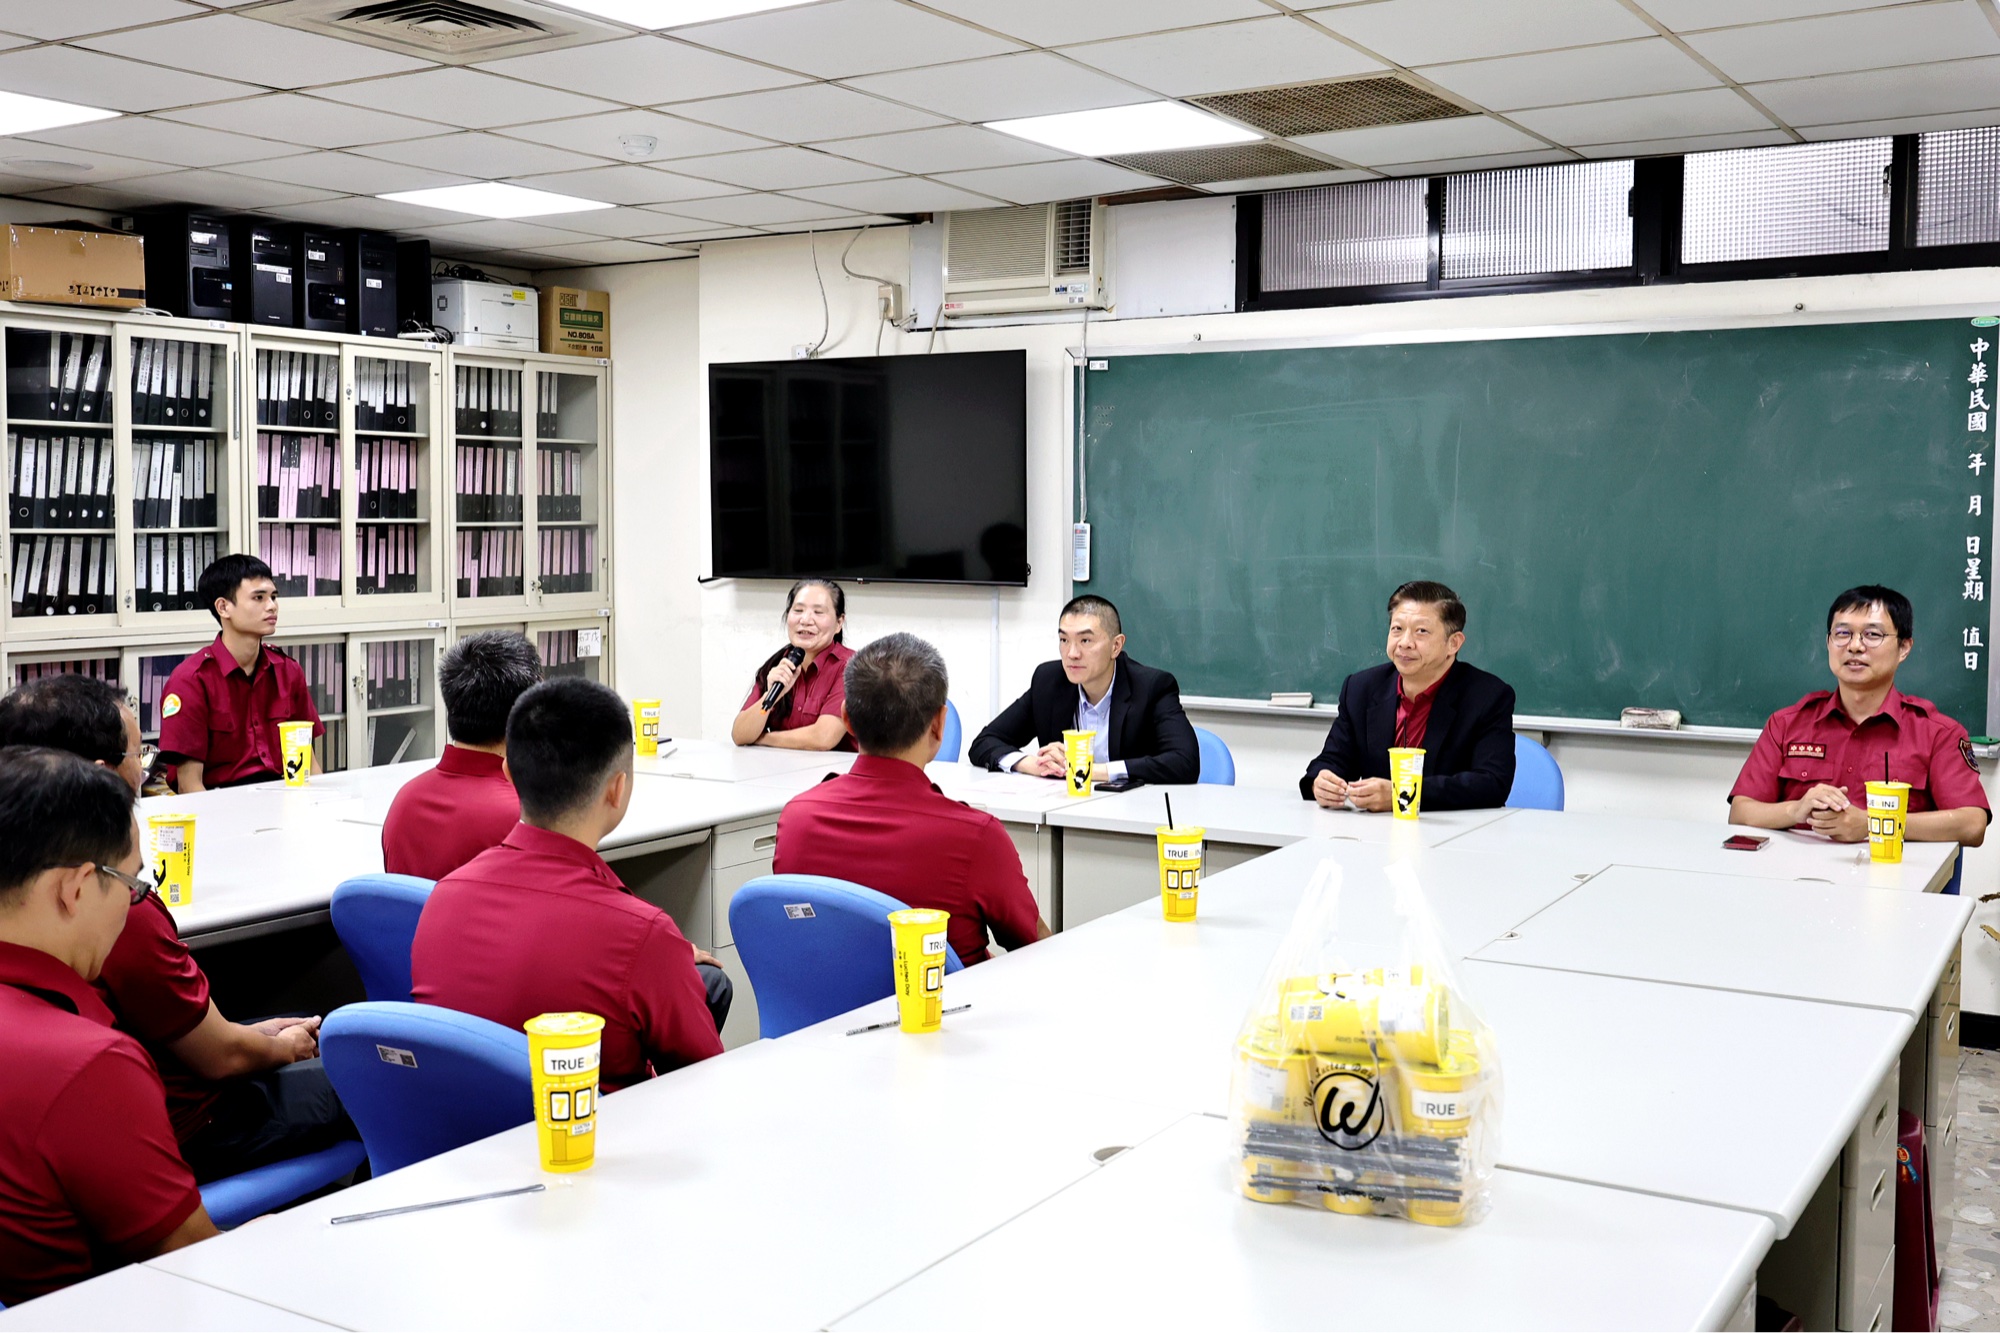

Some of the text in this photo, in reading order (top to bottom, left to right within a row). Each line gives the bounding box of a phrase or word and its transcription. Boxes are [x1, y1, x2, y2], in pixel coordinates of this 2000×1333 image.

[1967, 337, 1990, 432] 中華民國
[1968, 452, 1987, 477] 年
[1967, 494, 1983, 517] 月
[1962, 626, 1984, 671] 值日
[1168, 850, 1188, 858] TRUE
[551, 1057, 585, 1071] TRUE
[1351, 1063, 1376, 1080] Day
[554, 1098, 567, 1115] 7
[1420, 1102, 1455, 1115] TRUE
